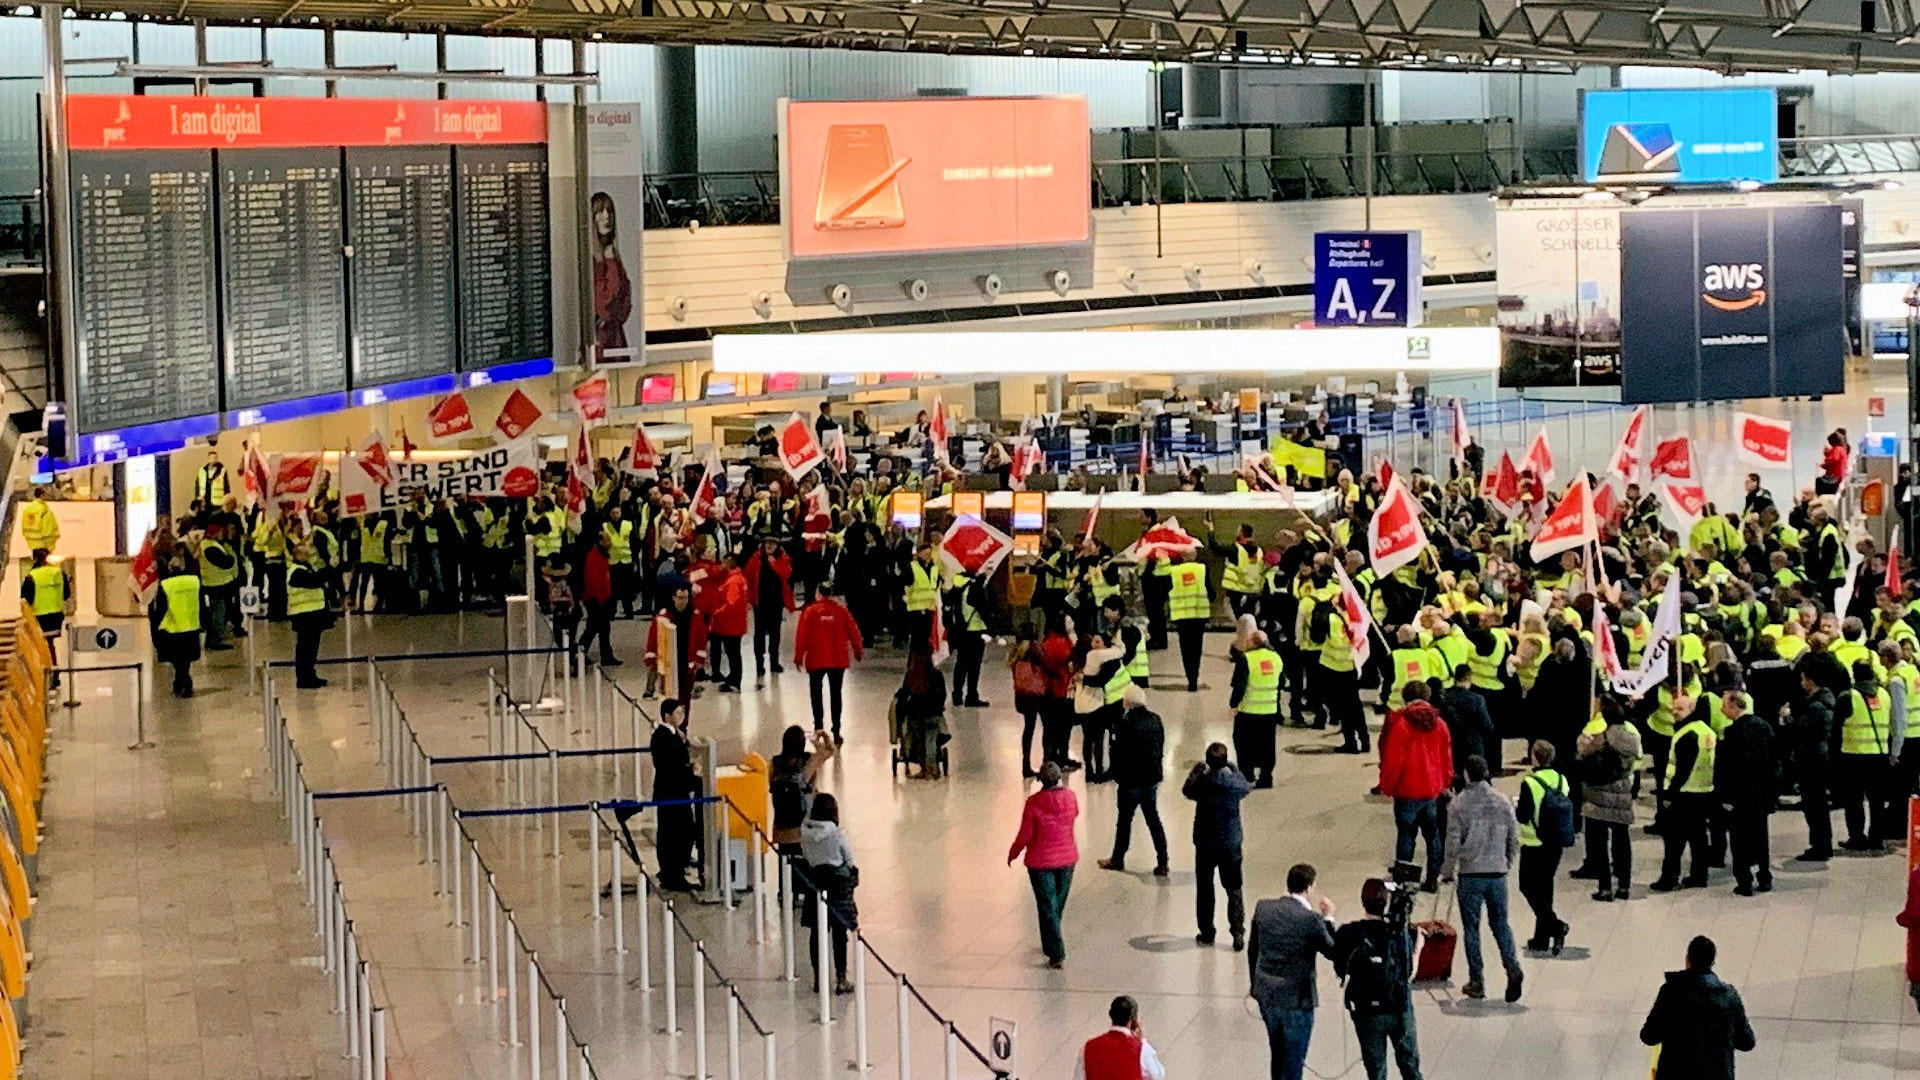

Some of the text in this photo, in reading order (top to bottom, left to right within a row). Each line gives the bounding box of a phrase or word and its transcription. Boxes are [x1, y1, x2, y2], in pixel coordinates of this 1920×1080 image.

[171, 103, 262, 142] I am digital
[434, 106, 502, 139] I am digital
[597, 110, 631, 127] digital
[1536, 217, 1614, 232] GROSSER
[1704, 263, 1763, 290] aws
[438, 449, 508, 478] SIND
[424, 471, 502, 500] WERT
